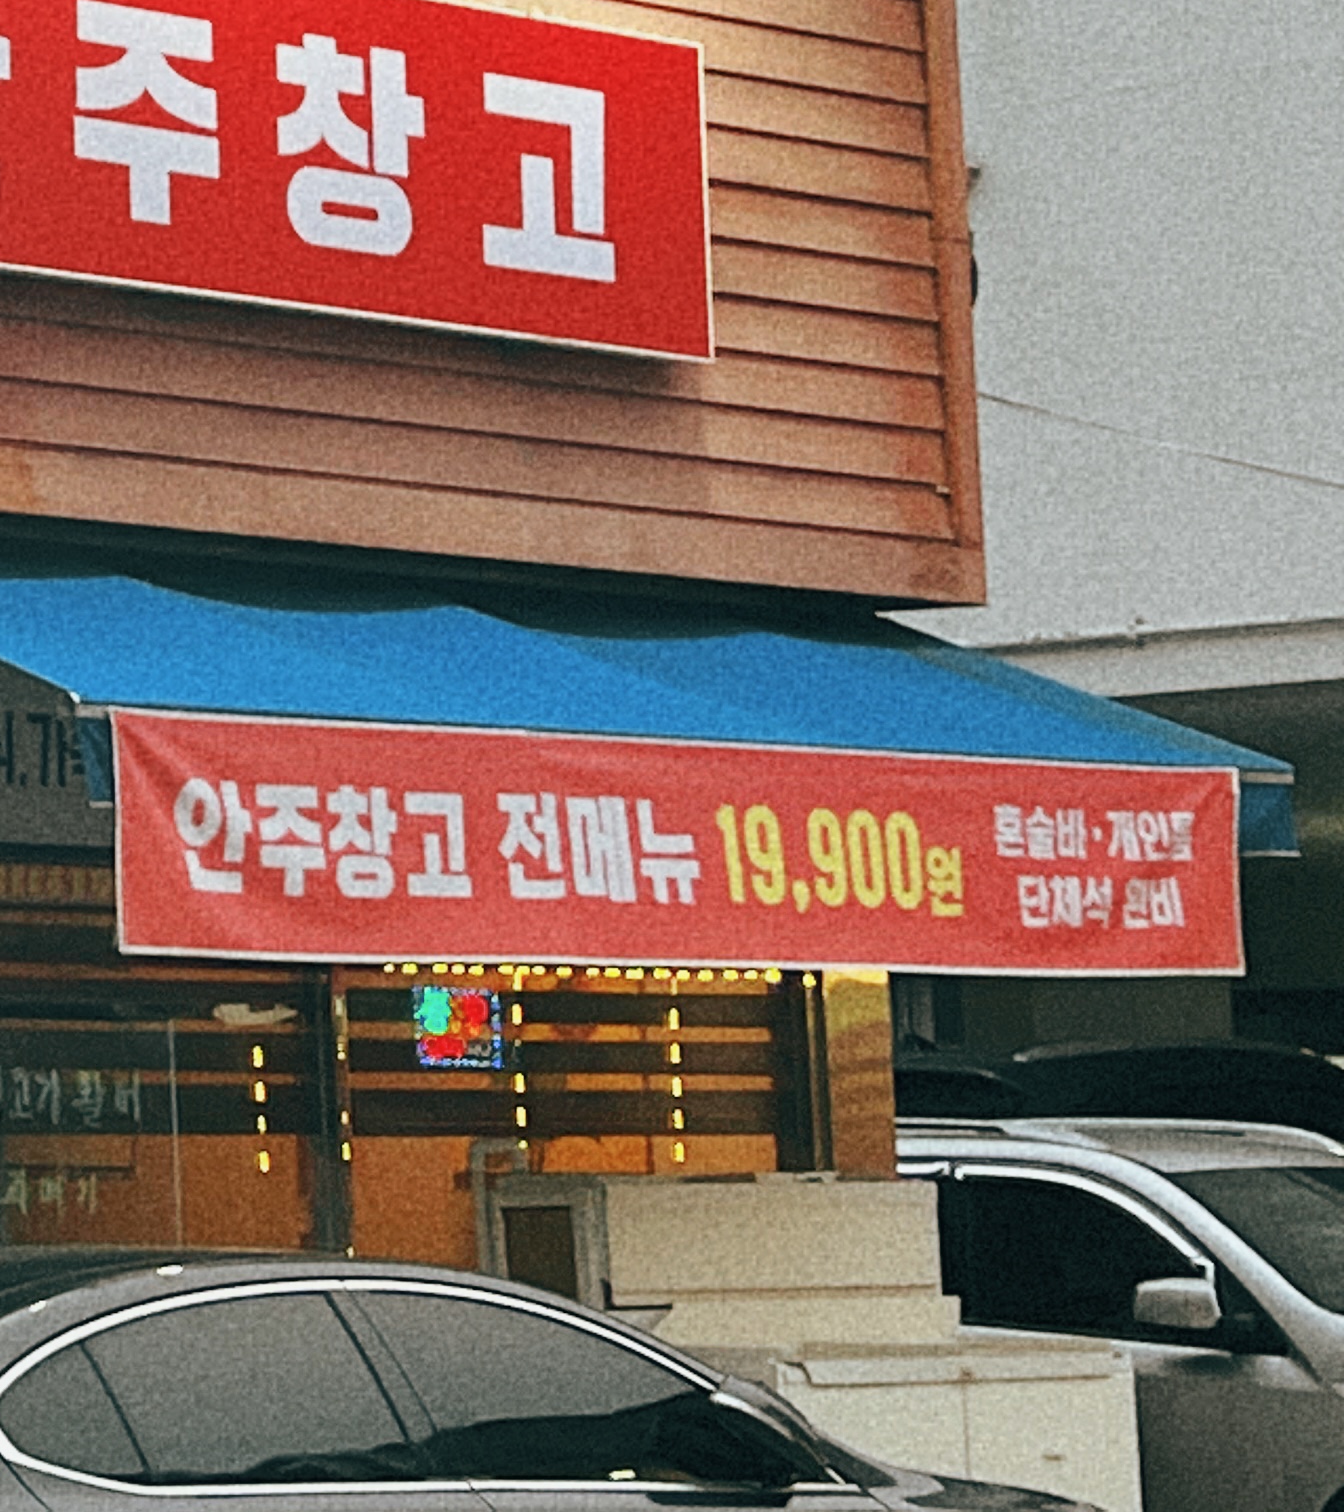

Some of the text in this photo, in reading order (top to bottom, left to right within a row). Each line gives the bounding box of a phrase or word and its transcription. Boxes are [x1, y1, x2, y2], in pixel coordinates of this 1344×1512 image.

[174, 776, 964, 917] 안주창고 전메뉴 19,900원
[1017, 874, 1185, 930] 단체석 완비
